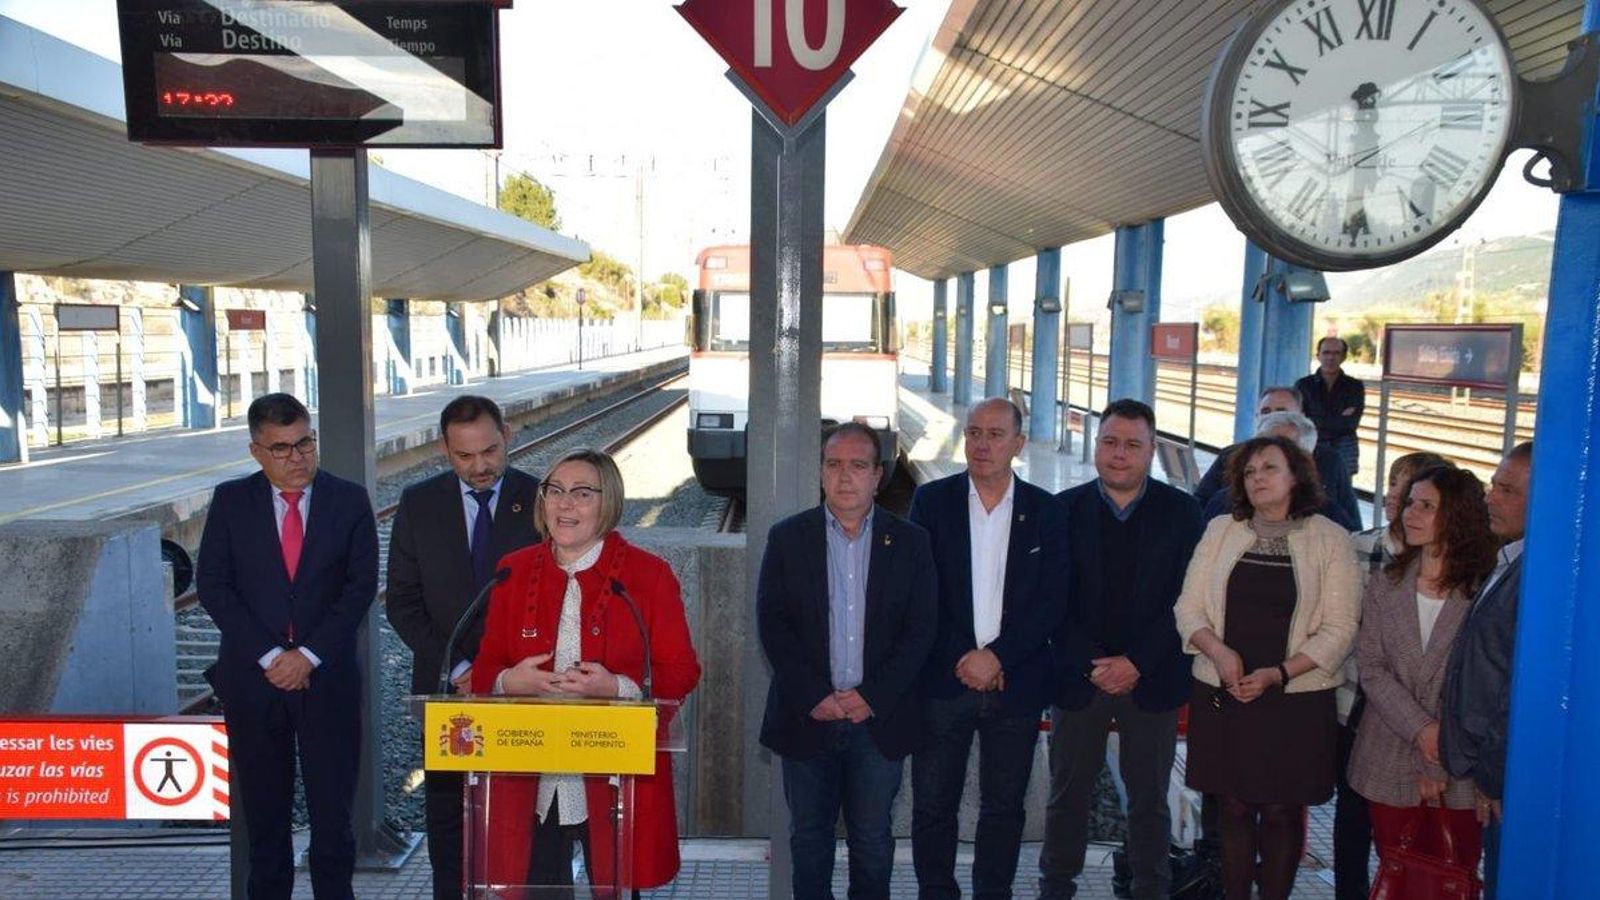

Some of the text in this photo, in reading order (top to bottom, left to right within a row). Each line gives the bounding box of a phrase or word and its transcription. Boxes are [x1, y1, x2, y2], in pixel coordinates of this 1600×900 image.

[157, 10, 181, 25] Via
[385, 15, 428, 32] Temps
[222, 29, 304, 50] Destino
[753, 0, 847, 71] 10
[496, 729, 545, 738] GOBIERNO
[497, 737, 544, 747] DE ESPAÑA
[570, 731, 618, 739] MINISTERIO
[0, 734, 114, 751] essar les vies
[571, 740, 626, 749] DE FOMENTO
[0, 761, 104, 778] uzar las vías
[7, 788, 110, 807] is prohibited
